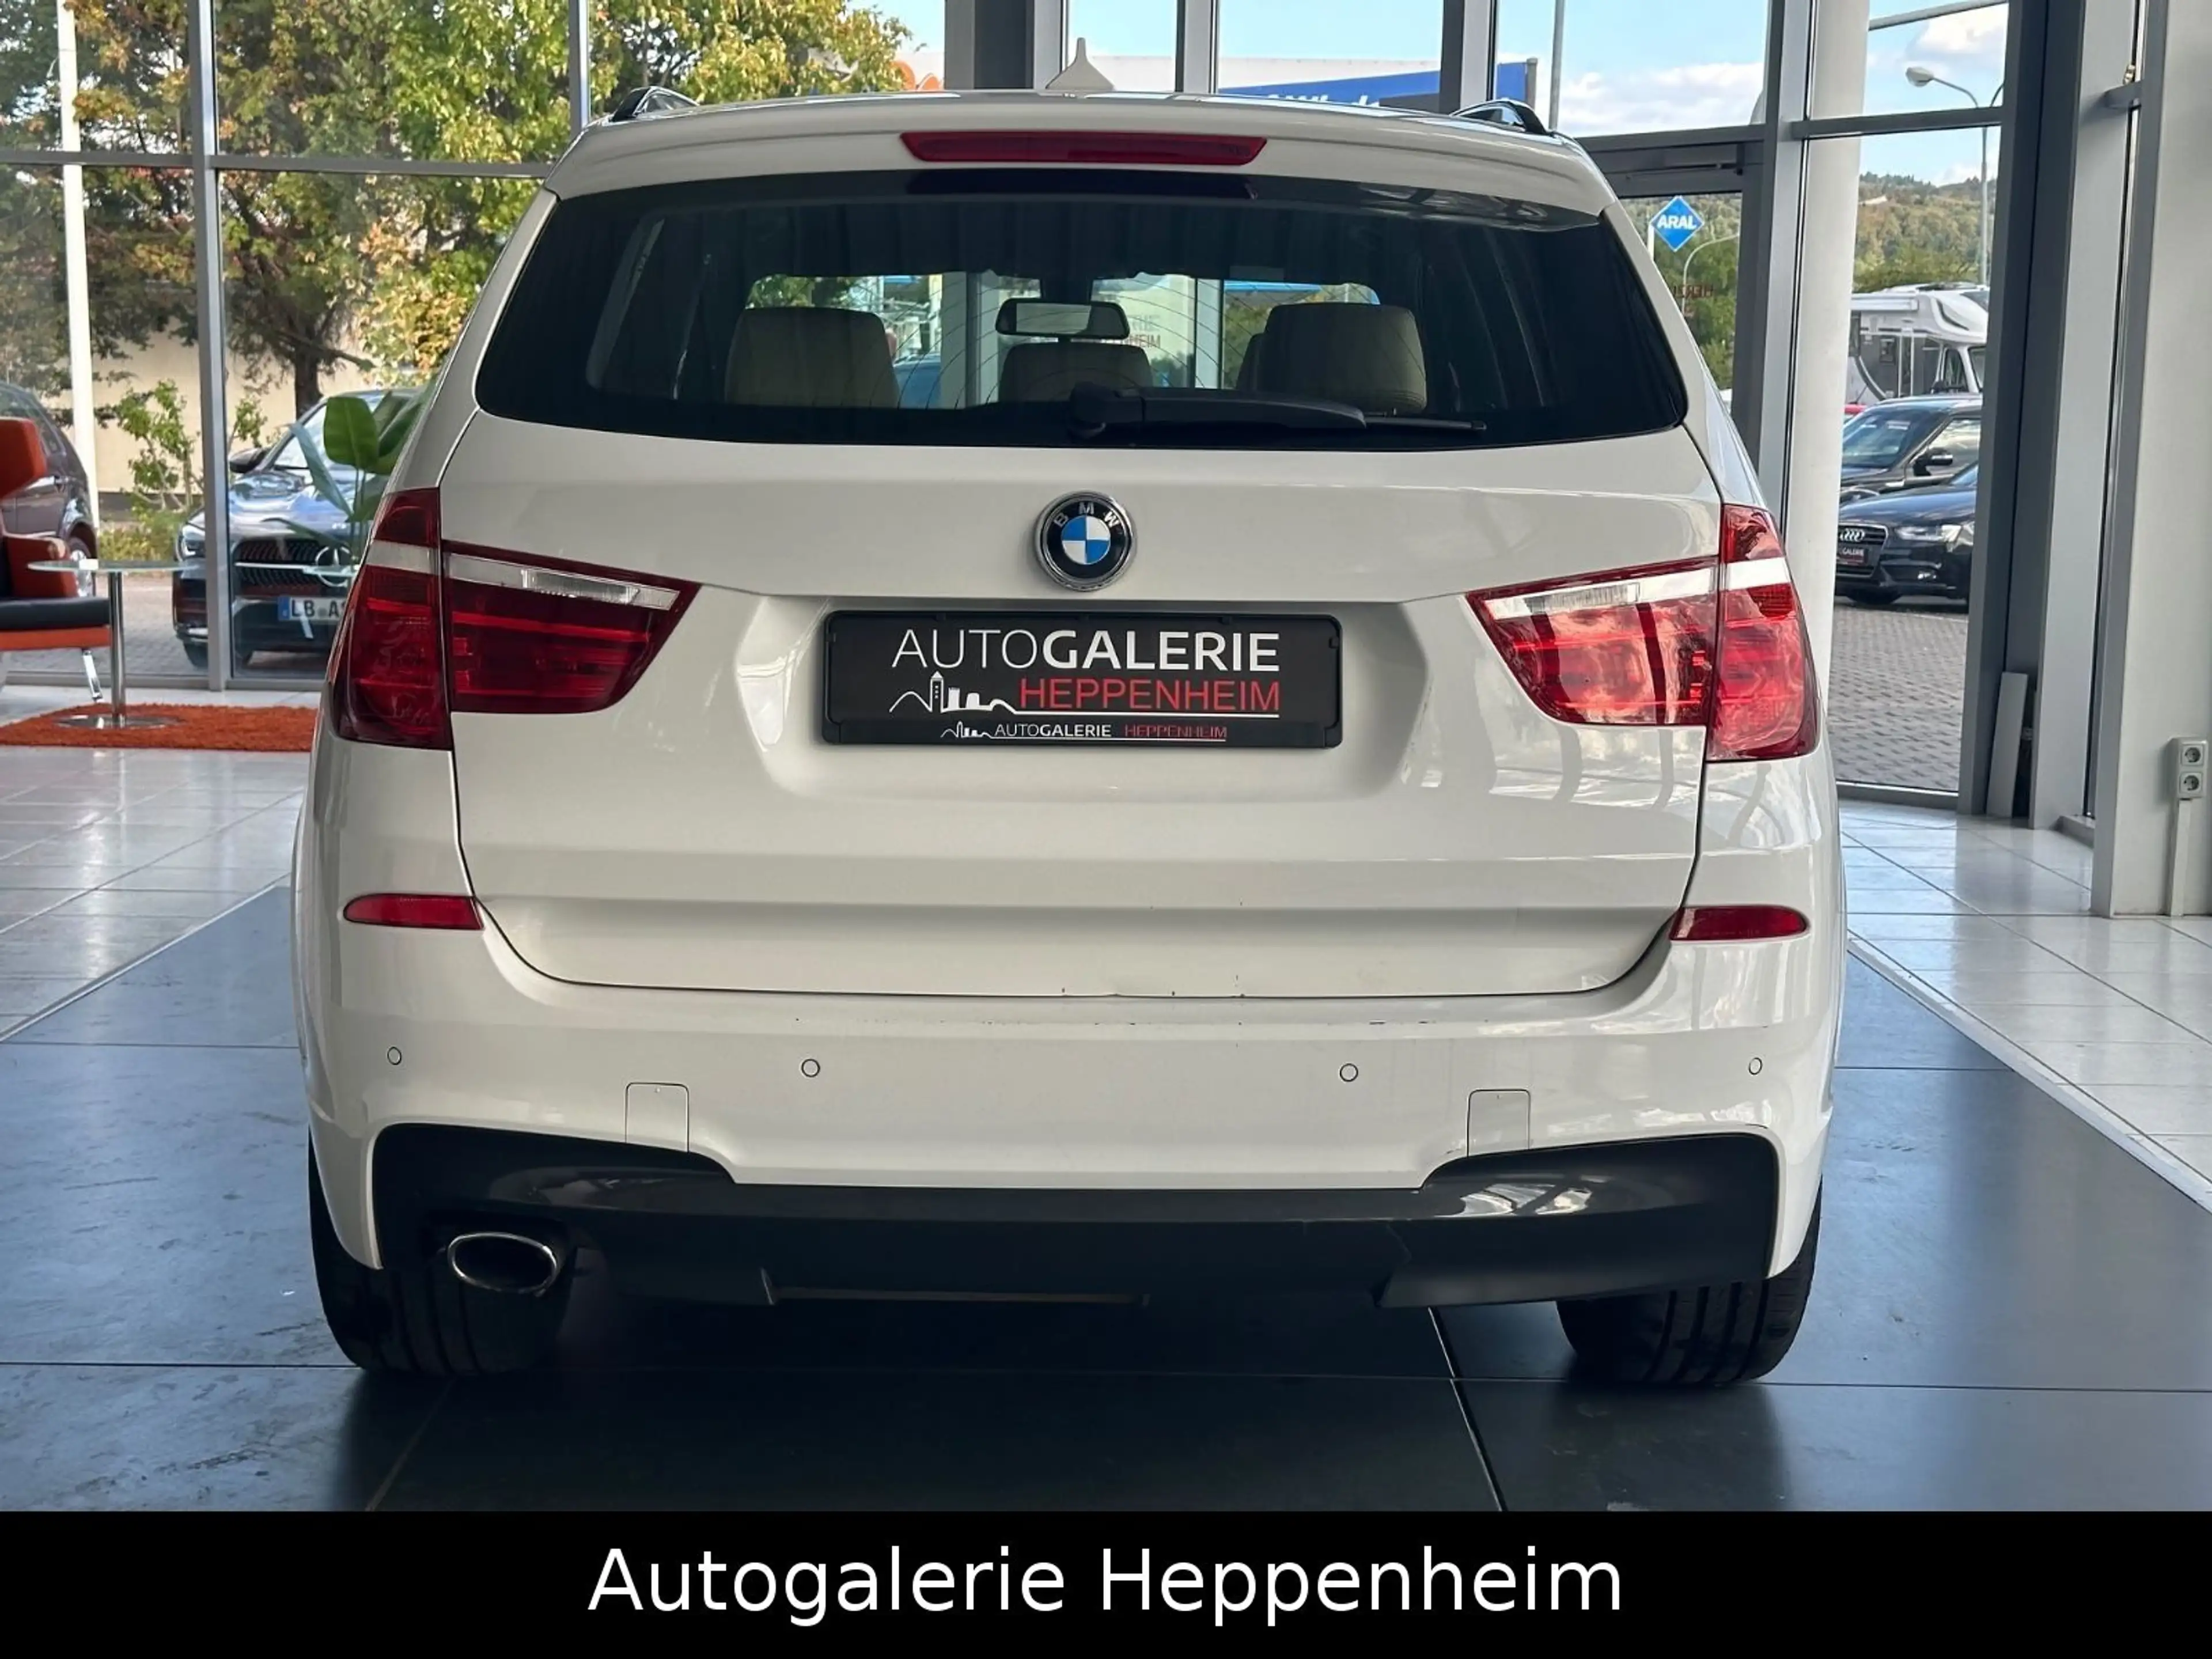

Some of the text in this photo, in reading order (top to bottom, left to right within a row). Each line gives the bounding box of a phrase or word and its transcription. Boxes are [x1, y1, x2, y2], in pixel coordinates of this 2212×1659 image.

[1657, 214, 1697, 229] ARAL
[1053, 501, 1120, 528] BMW
[291, 599, 315, 617] LB
[891, 628, 1280, 671] AUTOGALERIE
[1019, 677, 1279, 711] HEPPENHEIM
[994, 724, 1227, 740] AUTOGALERIE HEPPENHEIM
